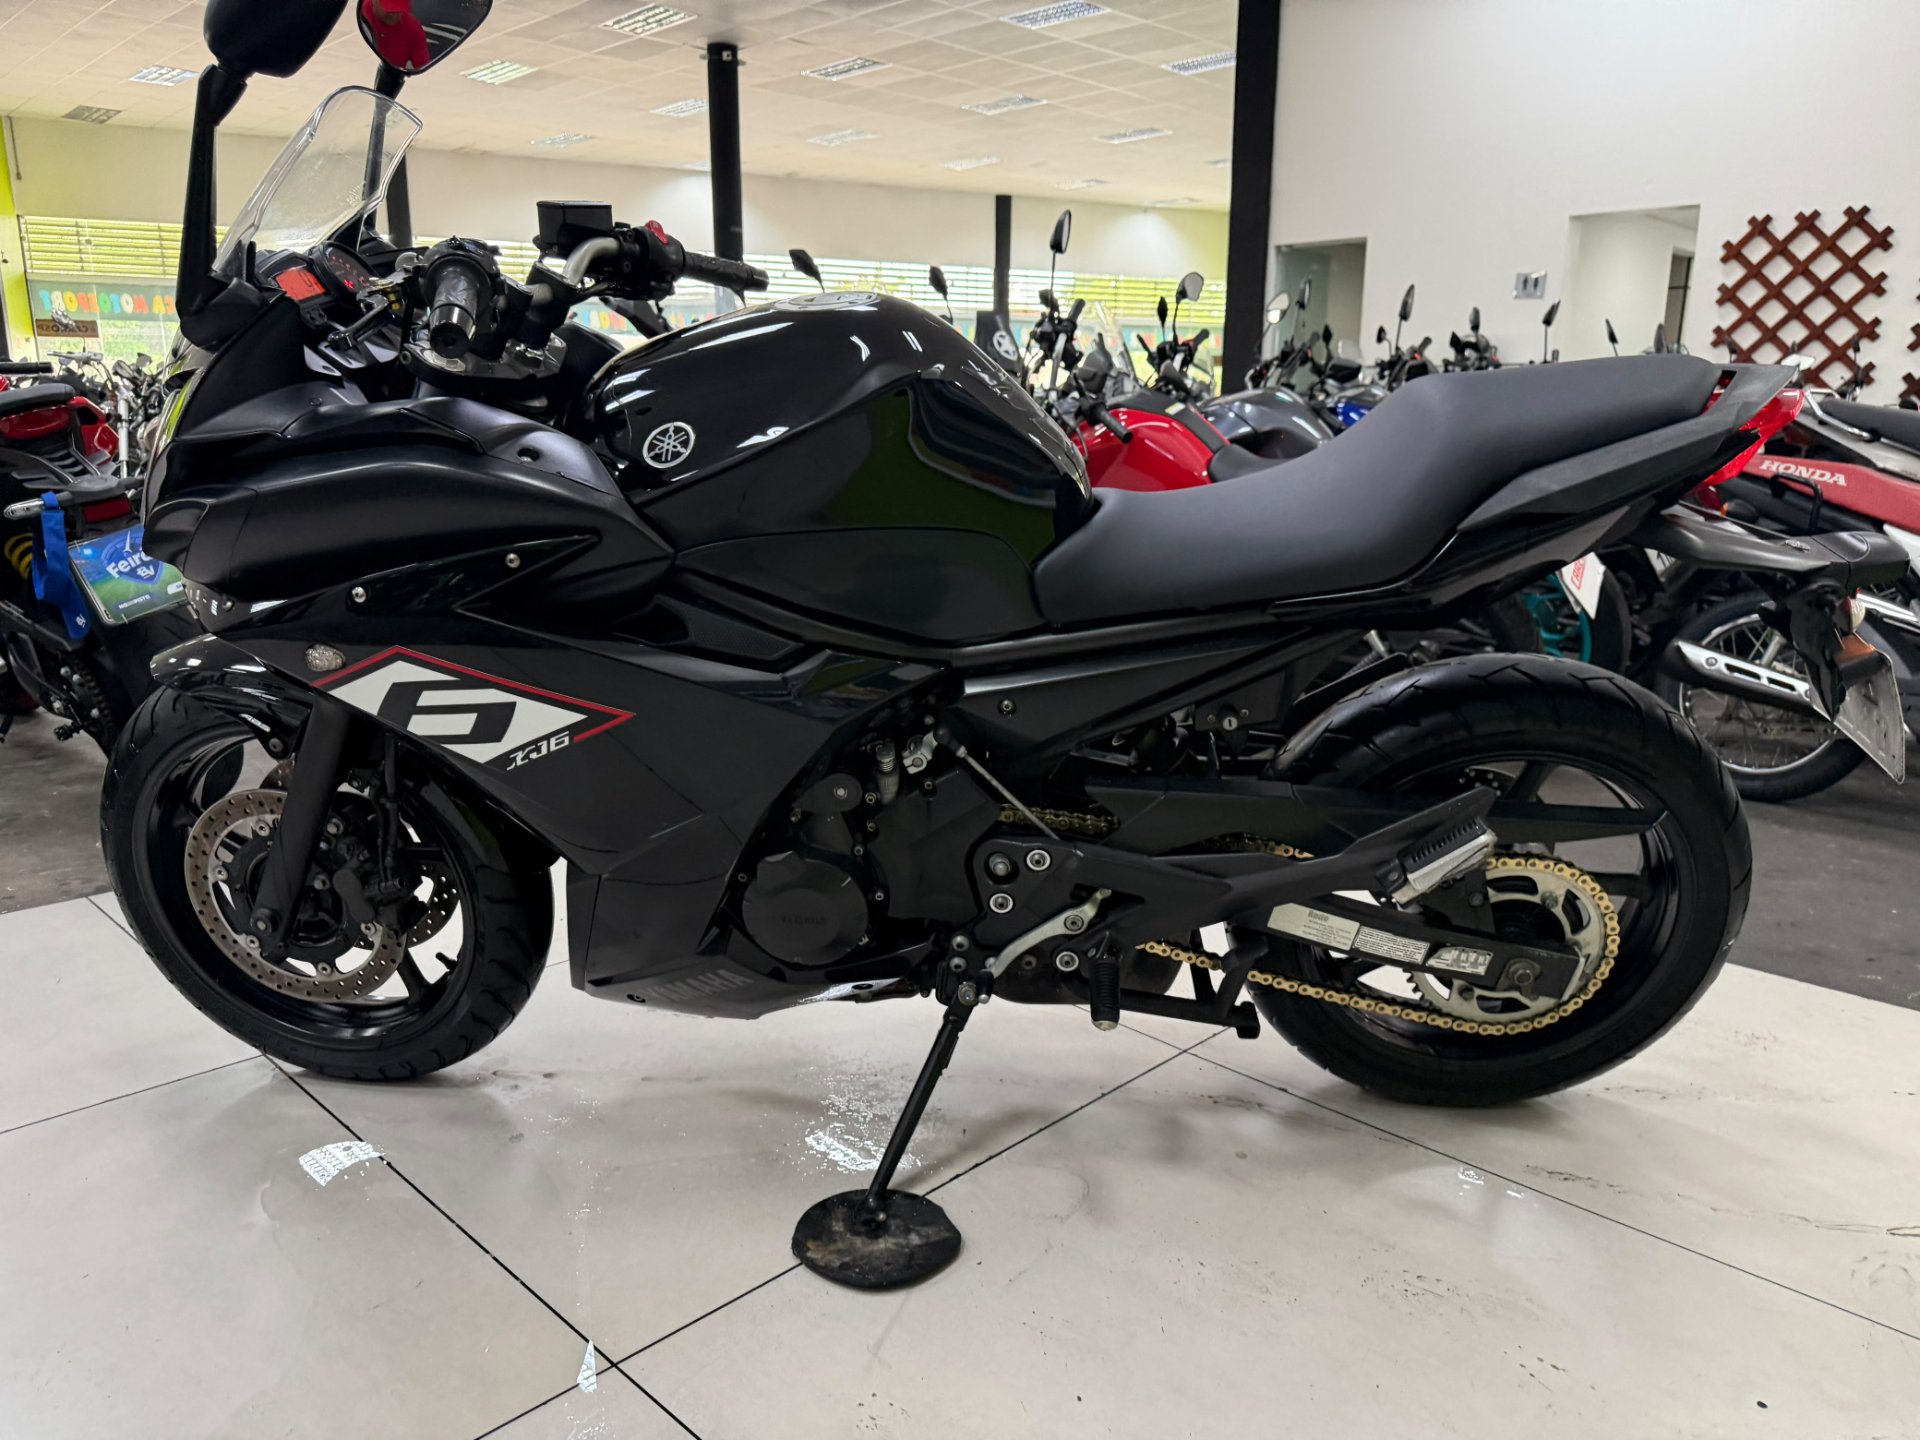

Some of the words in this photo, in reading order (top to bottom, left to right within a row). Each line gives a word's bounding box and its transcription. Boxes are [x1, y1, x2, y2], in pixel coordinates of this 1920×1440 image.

[1759, 459, 1847, 487] HONDA
[377, 678, 517, 745] 6
[506, 730, 570, 771] XJ6
